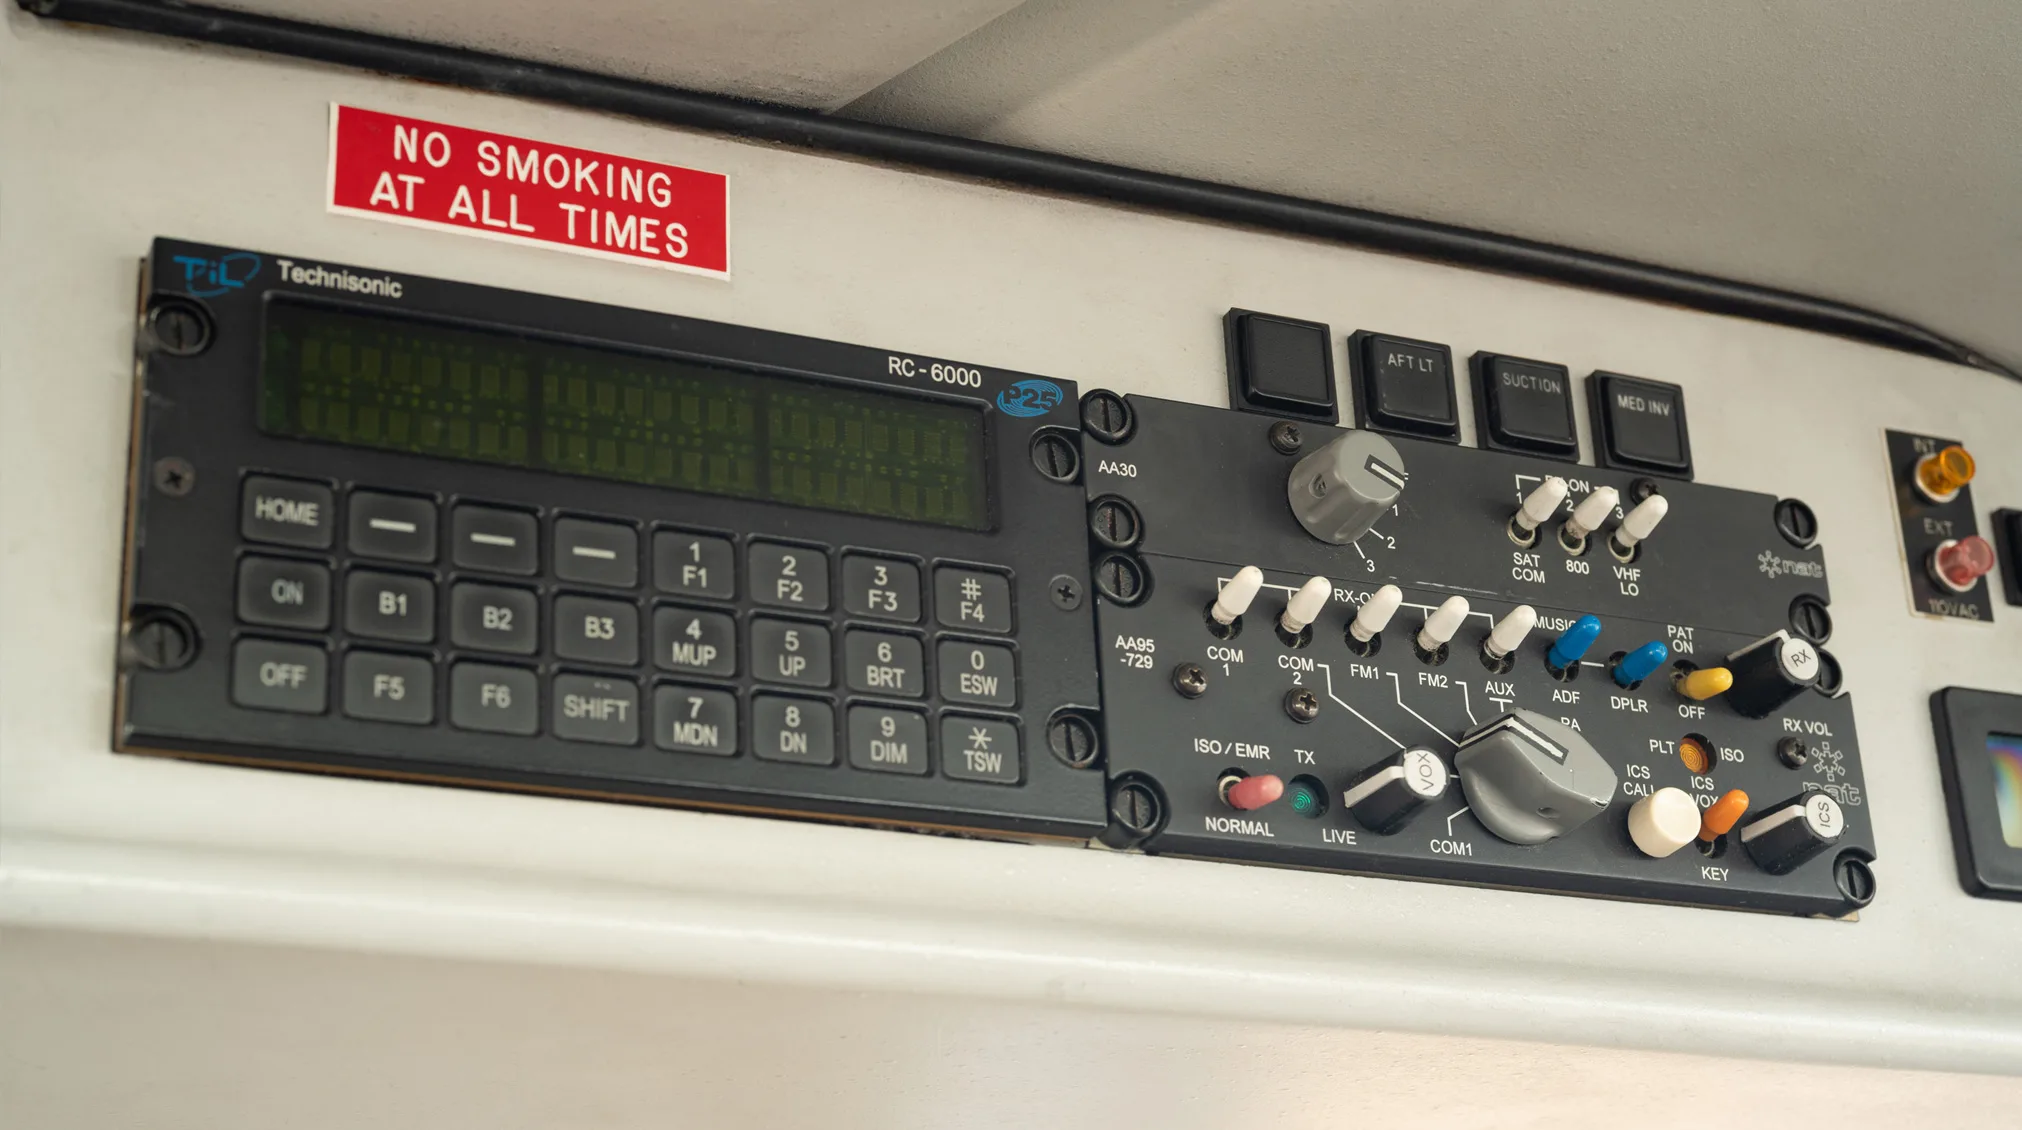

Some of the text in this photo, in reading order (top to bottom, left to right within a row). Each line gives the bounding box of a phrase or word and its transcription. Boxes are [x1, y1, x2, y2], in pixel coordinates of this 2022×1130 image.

[393, 124, 672, 208] NO SMOKING
[369, 171, 689, 259] AT ALL TIMES
[277, 259, 403, 298] Technisonic
[1388, 353, 1432, 372] AFT LT
[1503, 372, 1561, 393] SUCTION
[1001, 384, 1059, 411] P25
[1618, 395, 1669, 415] MED INV
[1913, 438, 1936, 453] INT
[1099, 460, 1136, 477] AA30
[1517, 492, 1522, 504] 1
[1565, 499, 1575, 512] 2
[256, 498, 318, 525] HOME
[1393, 504, 1398, 516] 1
[1615, 507, 1624, 519] 3
[1924, 518, 1952, 535] EXT
[690, 542, 699, 561] 1
[1387, 537, 1395, 549] 2
[783, 556, 796, 576] 2
[1367, 560, 1375, 572] 3
[1514, 552, 1540, 568] SAT
[1566, 560, 1589, 574] 800
[683, 566, 706, 587] F1
[875, 566, 887, 585] 3
[1513, 566, 1545, 583] COM
[1613, 566, 1640, 583] VHF
[272, 580, 303, 604] ON
[778, 580, 803, 601] F2
[961, 578, 981, 600] #
[1334, 588, 1375, 604] RX-O
[1620, 580, 1639, 596] LO
[380, 592, 406, 614] B1
[869, 590, 897, 611] F3
[484, 606, 512, 630] B2
[961, 601, 984, 622] F4
[585, 616, 614, 639] B3
[686, 619, 701, 639] 4
[1668, 625, 1693, 642] PAT
[785, 631, 799, 651] 5
[1116, 635, 1155, 655] AA95
[1673, 637, 1693, 653] ON
[673, 642, 716, 665] MUP
[878, 642, 891, 662] 6
[971, 651, 984, 670] 0
[1121, 651, 1153, 669] -729
[1207, 646, 1243, 664] COM
[1791, 649, 1811, 667] RX
[780, 656, 805, 676] UP
[1223, 663, 1229, 676] 1
[1278, 655, 1313, 673] COM
[1351, 664, 1378, 679] FM1
[260, 663, 305, 687] OFF
[867, 666, 904, 688] BRT
[961, 673, 997, 696] ESW
[1293, 672, 1302, 685] 2
[1419, 672, 1448, 688] FM2
[374, 675, 404, 700] F5
[482, 684, 510, 708] F6
[1485, 681, 1515, 698] AUX
[1553, 690, 1580, 703] ADF
[564, 695, 629, 721] SHIFT
[688, 697, 703, 718] 7
[1611, 696, 1648, 713] DPLR
[1679, 705, 1705, 719] OFF
[786, 706, 800, 727] 8
[674, 722, 717, 746] MDN
[881, 717, 895, 737] 9
[1783, 718, 1832, 736] RX VOL
[781, 731, 806, 753] DN
[871, 740, 907, 763] DIM
[1195, 739, 1222, 754] ISO
[1236, 743, 1270, 759] EMR
[1650, 739, 1674, 754] PLT
[964, 750, 1001, 773] TSW
[1294, 750, 1315, 764] TX
[1720, 748, 1744, 762] ISO
[1417, 753, 1434, 790] VOX
[1627, 764, 1650, 779] ICS
[1691, 776, 1714, 790] ICS
[1818, 802, 1831, 828] ICS
[1206, 817, 1274, 837] NORMAL
[1323, 829, 1356, 845] LIVE
[1431, 840, 1472, 856] COM1
[1702, 867, 1728, 881] KEY
